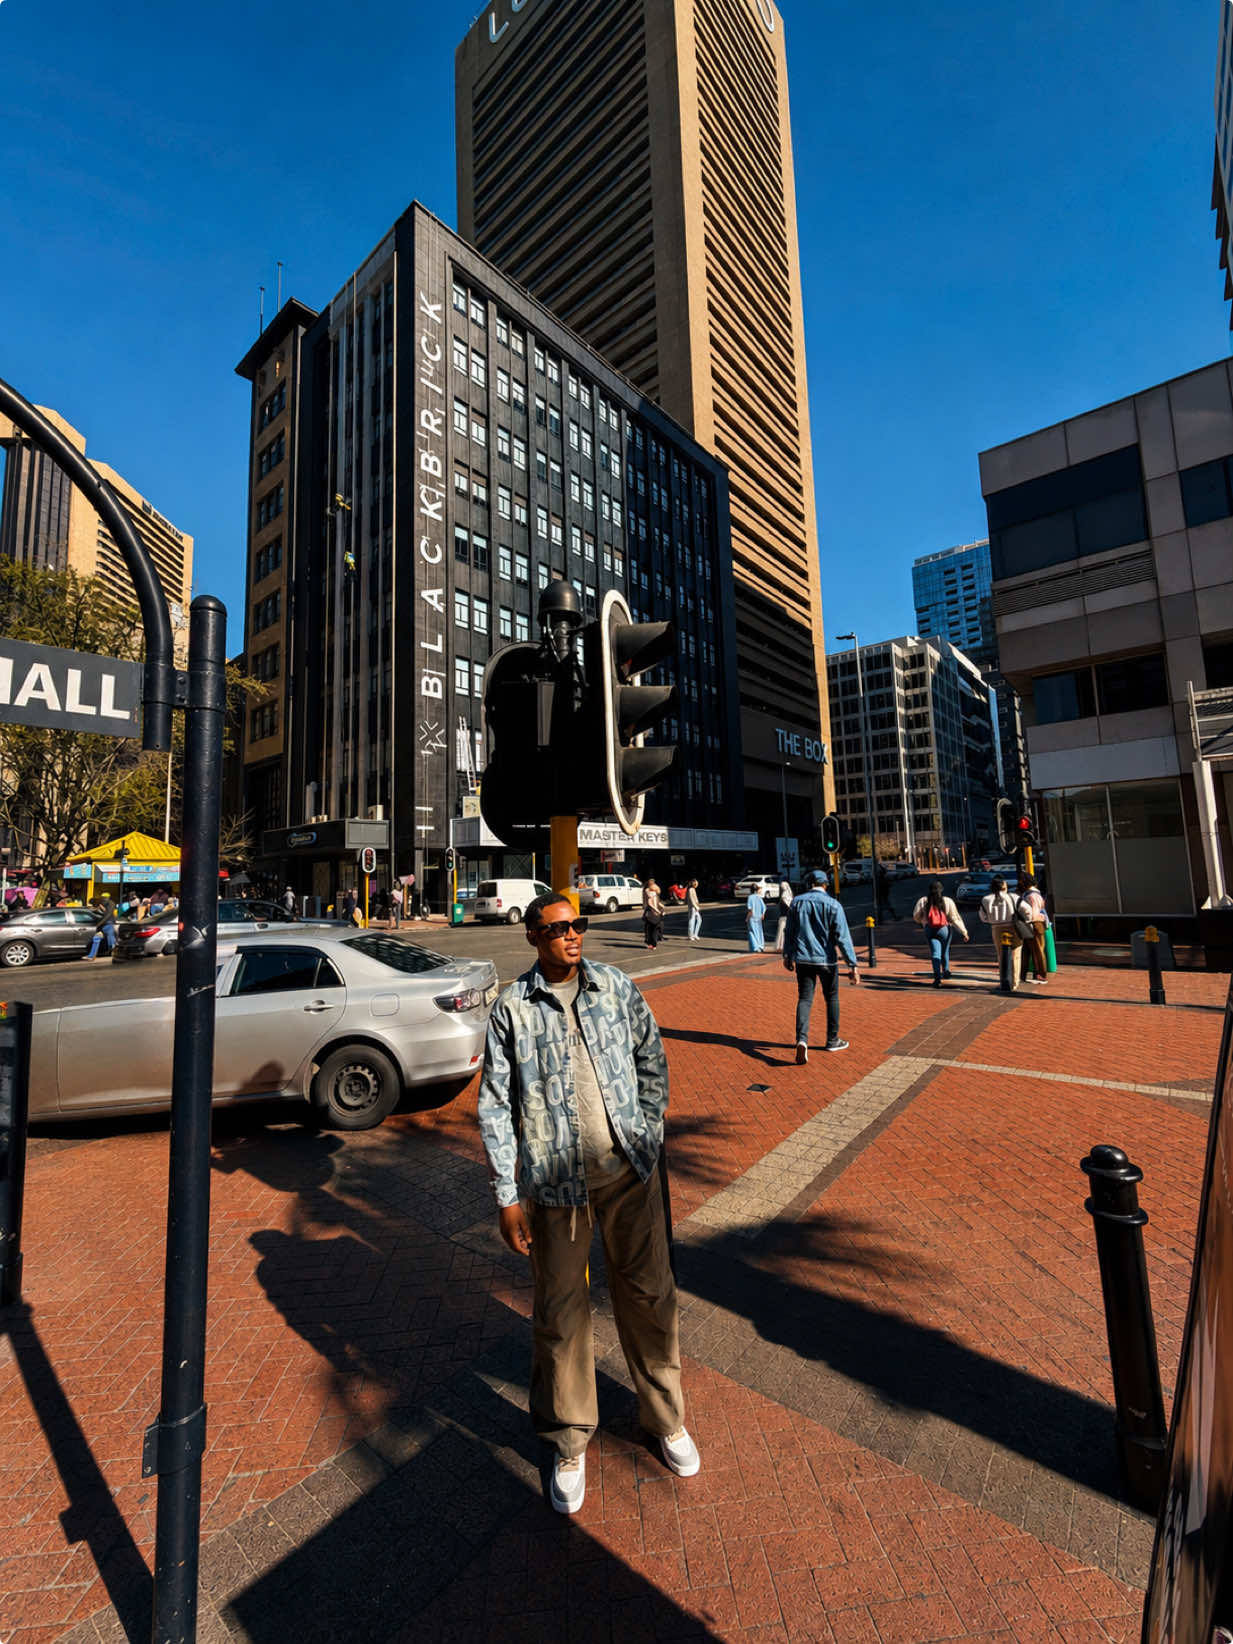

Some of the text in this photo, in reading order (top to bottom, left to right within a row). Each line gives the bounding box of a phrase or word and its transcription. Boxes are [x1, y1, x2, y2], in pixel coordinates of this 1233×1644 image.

[419, 290, 443, 699] BLACKBRICK
[0, 656, 131, 720] ALL
[775, 727, 830, 766] THE BOX
[639, 832, 668, 843] KEYS
